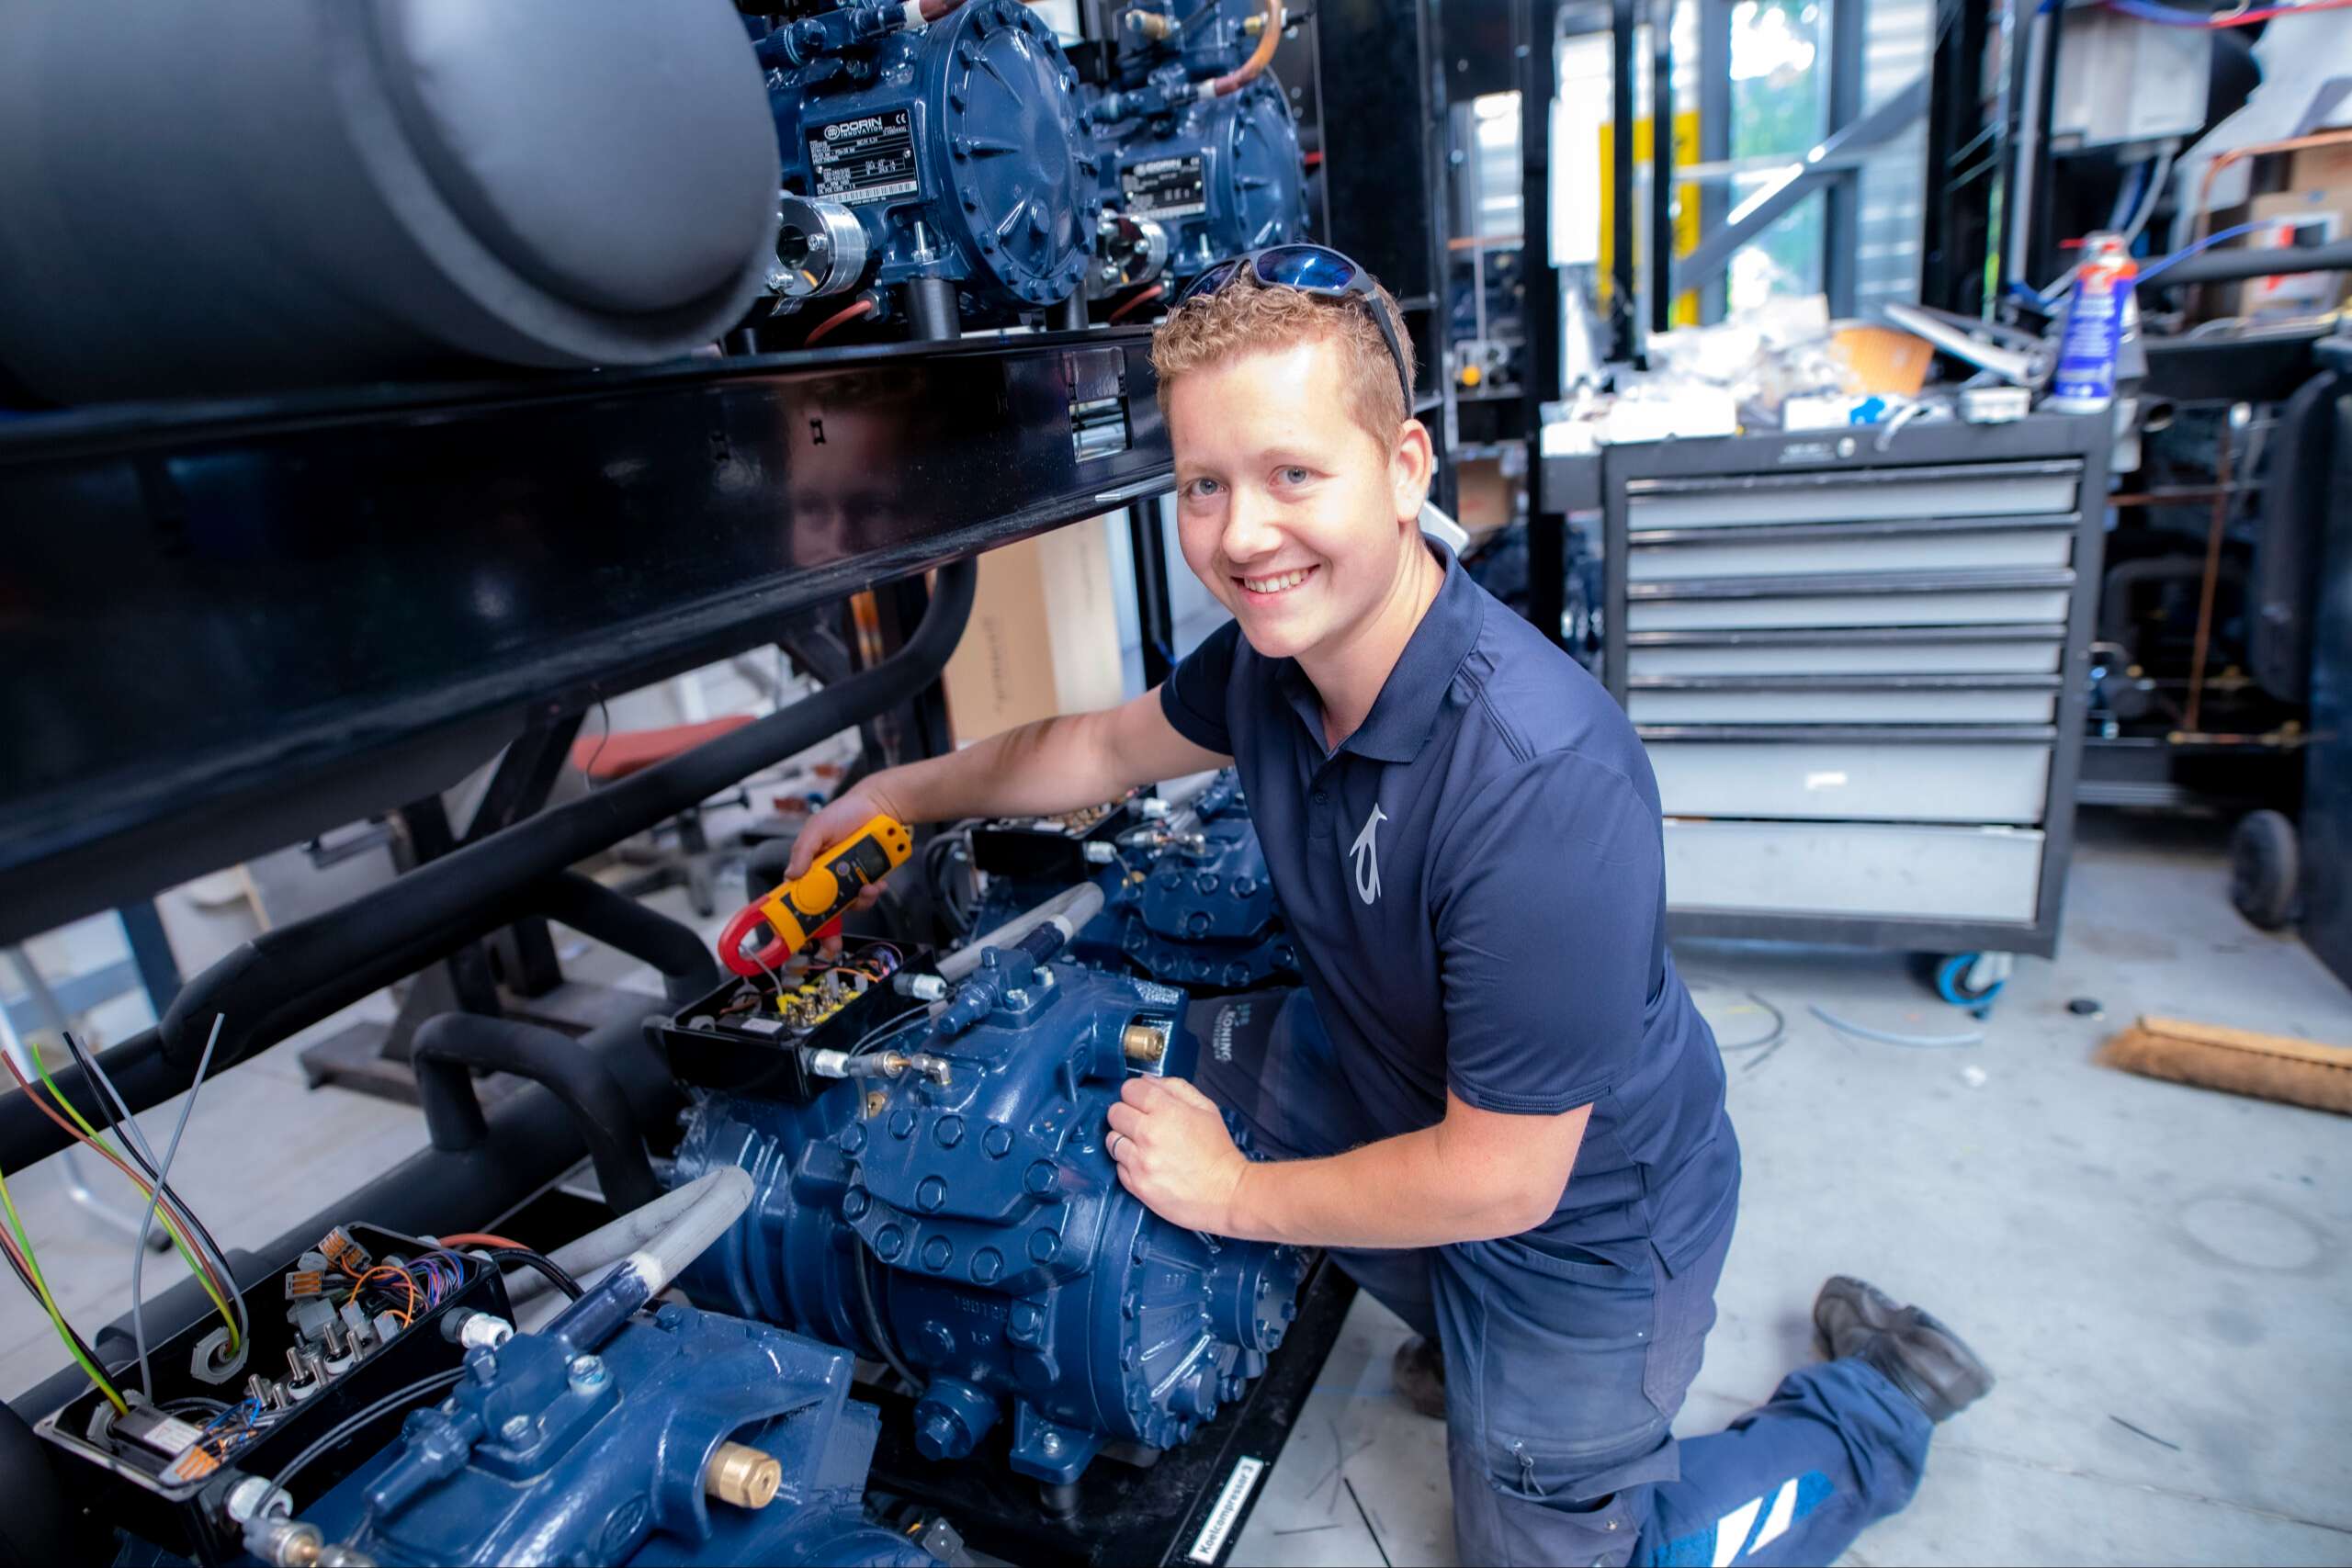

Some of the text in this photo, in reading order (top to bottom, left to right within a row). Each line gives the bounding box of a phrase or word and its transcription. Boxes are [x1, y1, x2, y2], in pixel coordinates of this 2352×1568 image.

[840, 116, 882, 132] DORIN
[841, 126, 884, 139] INNOVATION
[1220, 1010, 1237, 1062] KONING
[1198, 1472, 1250, 1554] Koelcompressor
